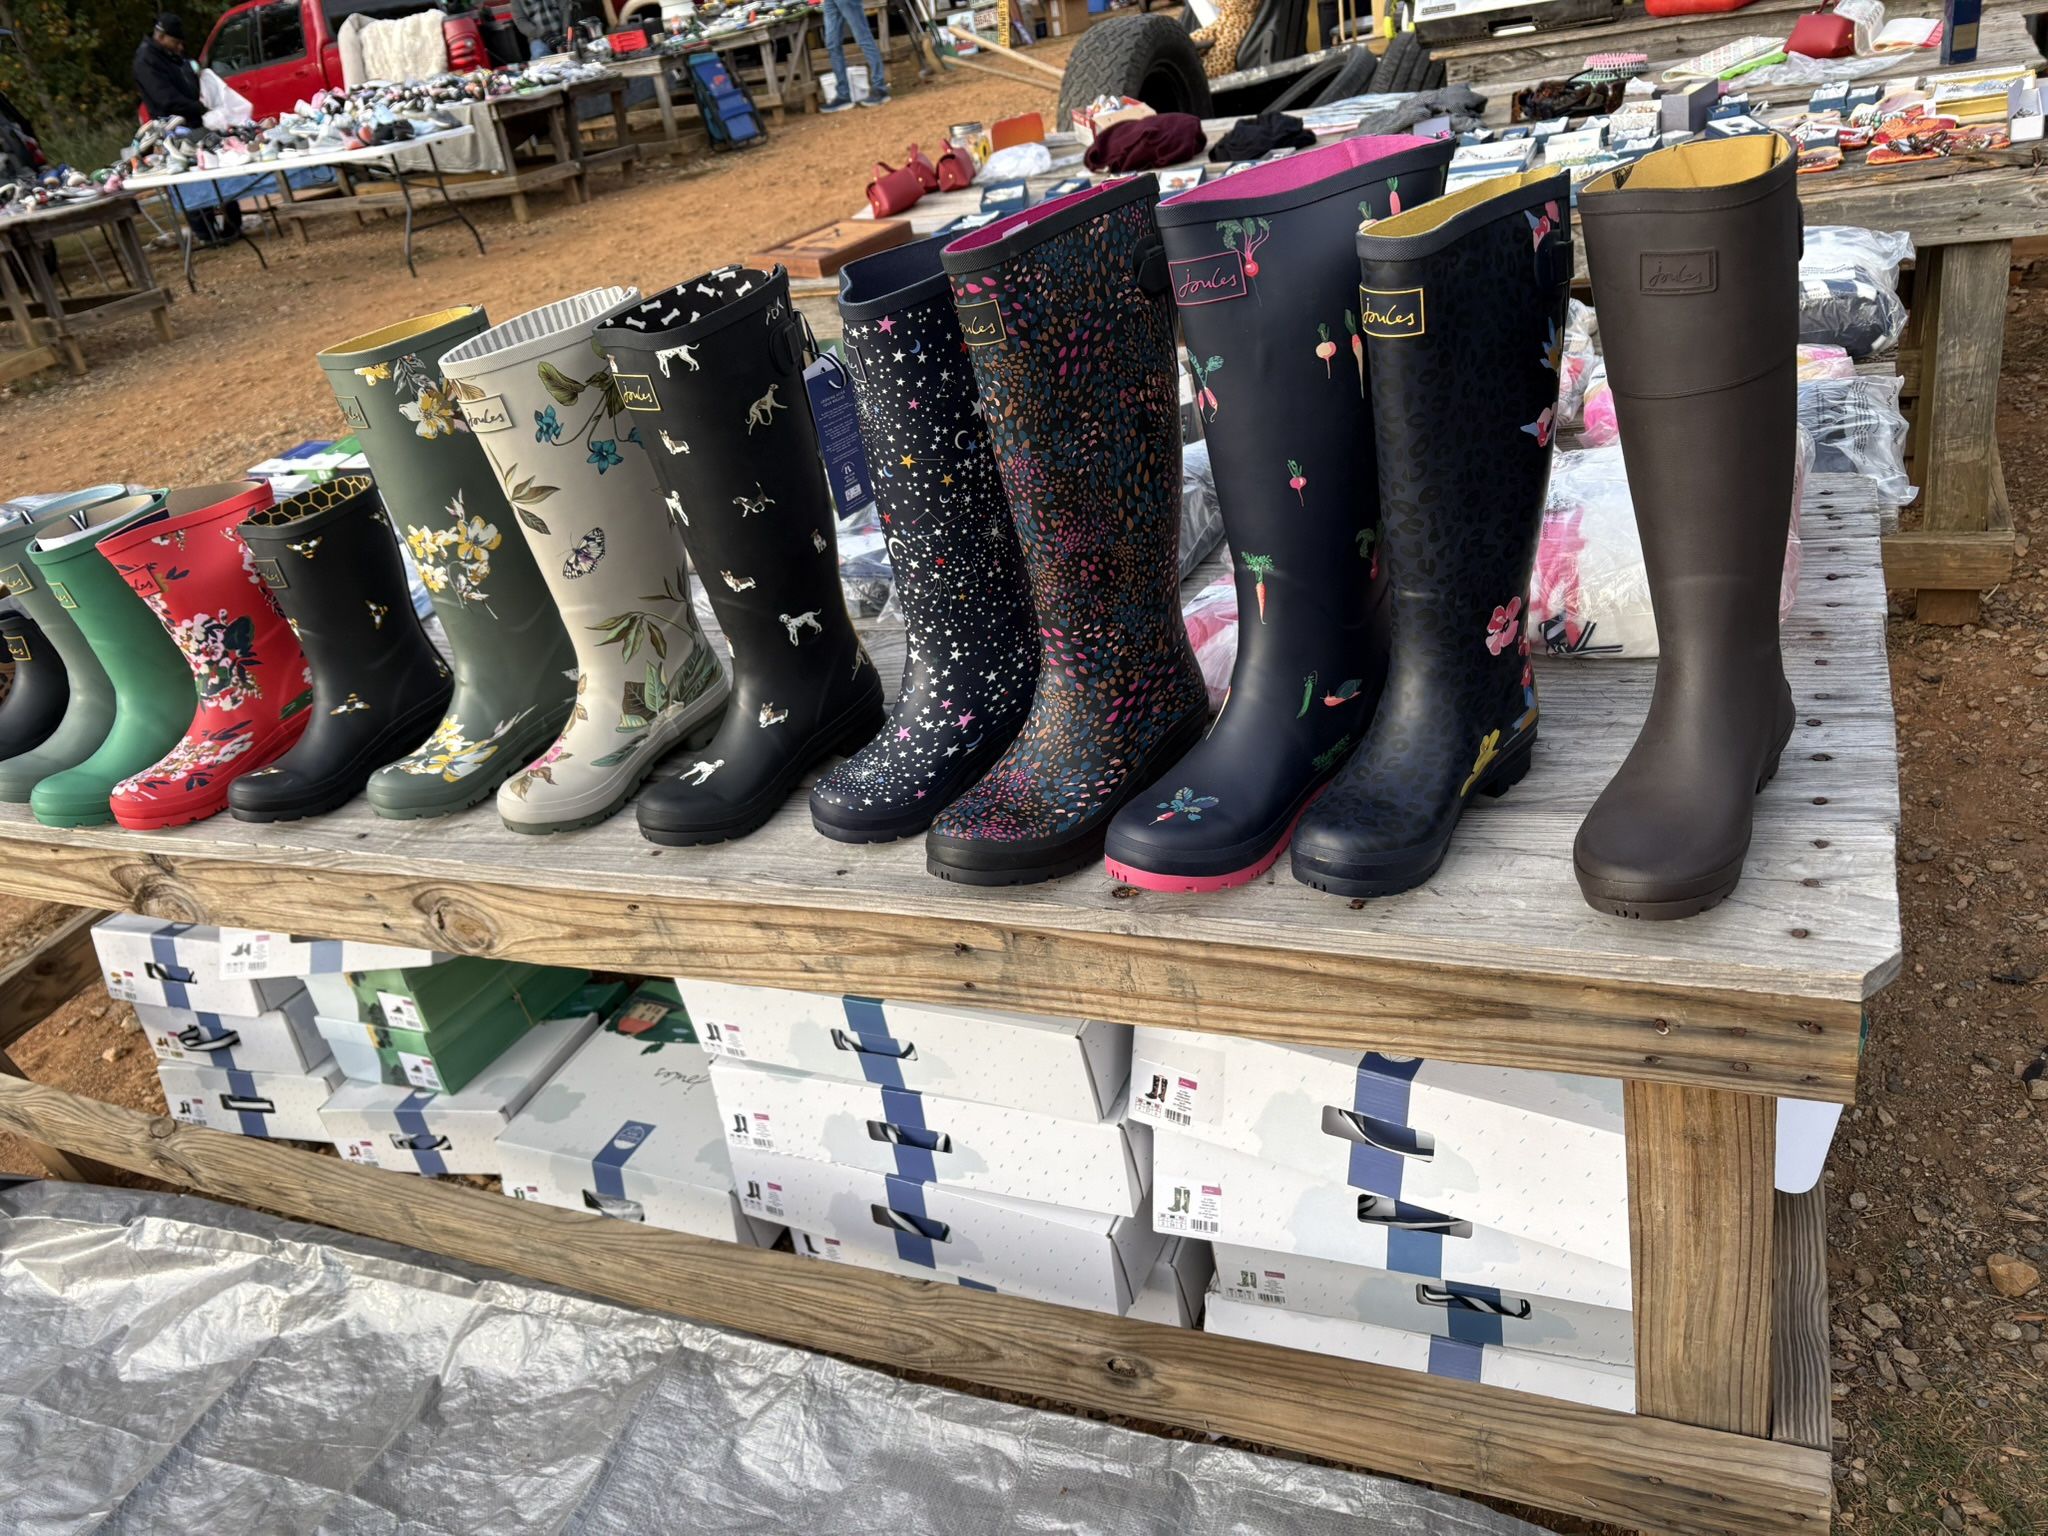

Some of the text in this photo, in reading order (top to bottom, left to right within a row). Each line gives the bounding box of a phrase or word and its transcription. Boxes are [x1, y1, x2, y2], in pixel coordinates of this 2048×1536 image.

[1178, 268, 1237, 298] joules
[1649, 260, 1703, 287] joules
[1363, 297, 1415, 326] joules
[959, 316, 997, 335] oules
[622, 380, 653, 403] joules
[466, 408, 505, 427] joules
